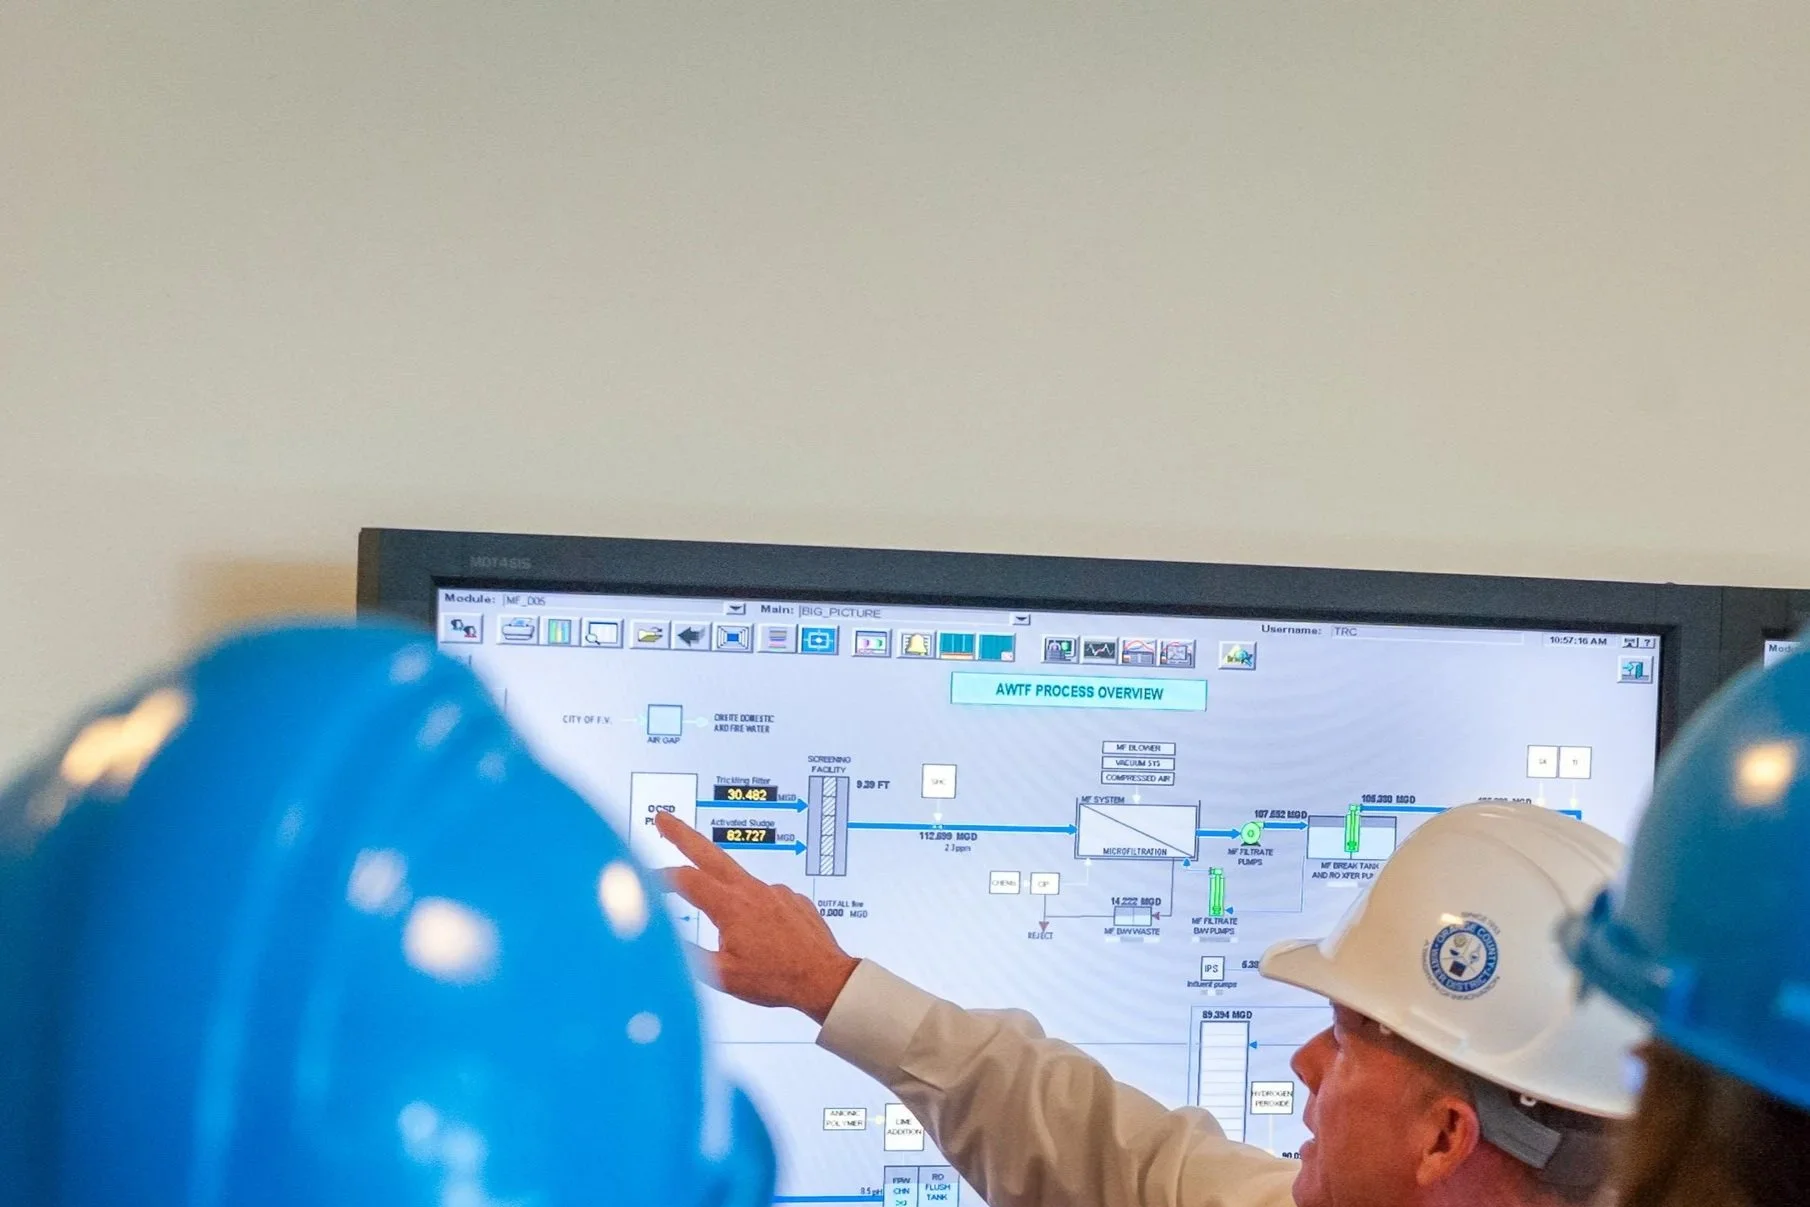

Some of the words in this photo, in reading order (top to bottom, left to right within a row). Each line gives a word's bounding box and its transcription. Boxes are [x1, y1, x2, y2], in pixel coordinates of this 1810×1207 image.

[444, 592, 496, 604] Module:
[760, 604, 794, 615] Main:
[801, 607, 882, 619] BIG_PICTURE
[1261, 624, 1322, 636] Username:
[1334, 627, 1358, 637] TRC
[1550, 635, 1589, 646] 10:57:16
[1590, 637, 1608, 647] AM
[995, 682, 1032, 697] AWTF
[1035, 684, 1094, 699] PROCESS
[1097, 685, 1165, 701] OVERVIEW
[562, 715, 581, 724] CITY
[584, 716, 595, 724] OF
[746, 725, 770, 734] WATER
[716, 775, 750, 786] Trickling
[752, 776, 771, 785] Filter
[1105, 774, 1156, 782] COMPRESSED
[877, 780, 890, 790] FT
[727, 789, 767, 801] 30.482
[1093, 796, 1125, 804] SYSTEM
[711, 818, 747, 827] Activated
[749, 819, 775, 828] Sludge
[726, 830, 766, 841] 82.727
[956, 832, 977, 841] MGD
[1102, 847, 1168, 856] MICROFILTRATION
[1239, 849, 1273, 857] FILTRATE
[1238, 858, 1263, 866] PUMPS
[818, 900, 849, 908] OUTFALL
[1204, 918, 1238, 926] FILTRATE
[1027, 931, 1054, 940] REJECT
[1133, 928, 1160, 936] WASTE
[1210, 927, 1235, 935] PUMPS
[1232, 1010, 1253, 1019] MGD
[926, 1193, 948, 1201] TANK
